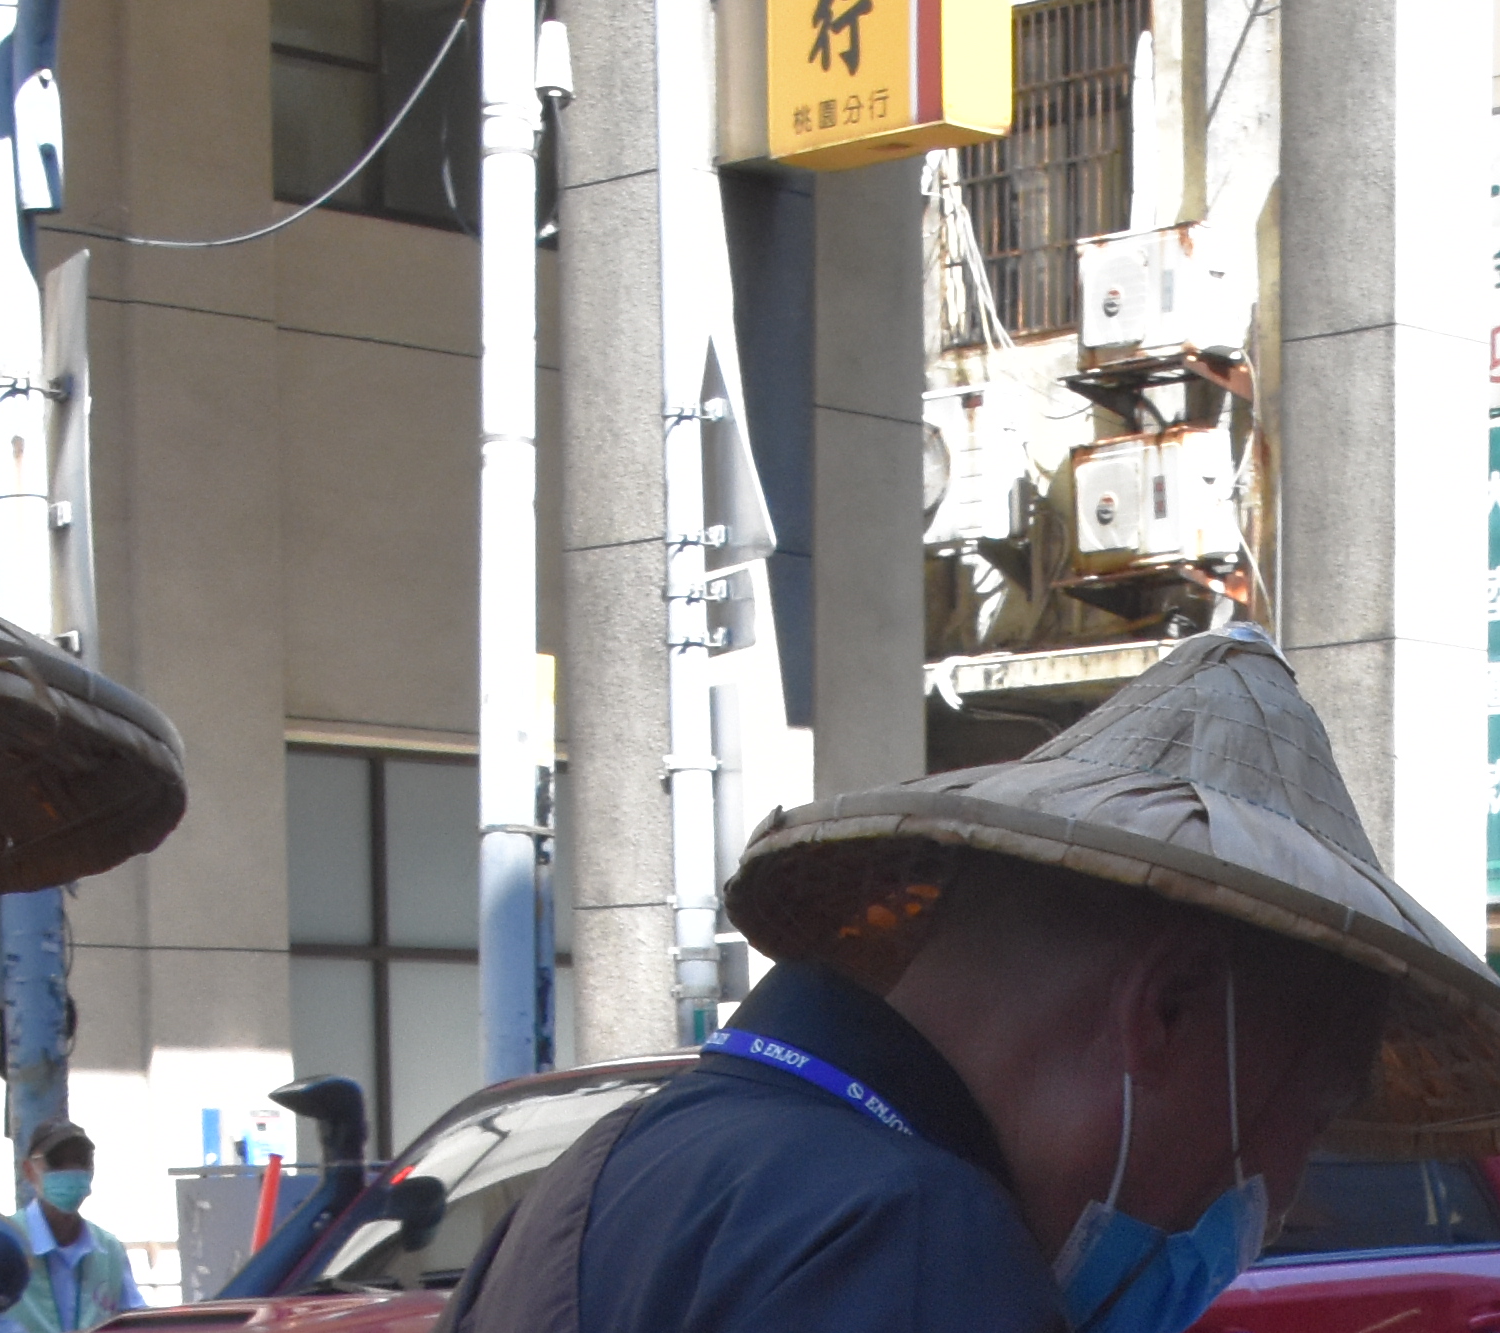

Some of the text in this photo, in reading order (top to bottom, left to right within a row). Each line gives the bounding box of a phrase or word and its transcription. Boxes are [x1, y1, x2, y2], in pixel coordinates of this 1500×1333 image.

[793, 87, 890, 136] 桃園分行
[762, 1042, 810, 1069] ENJOY
